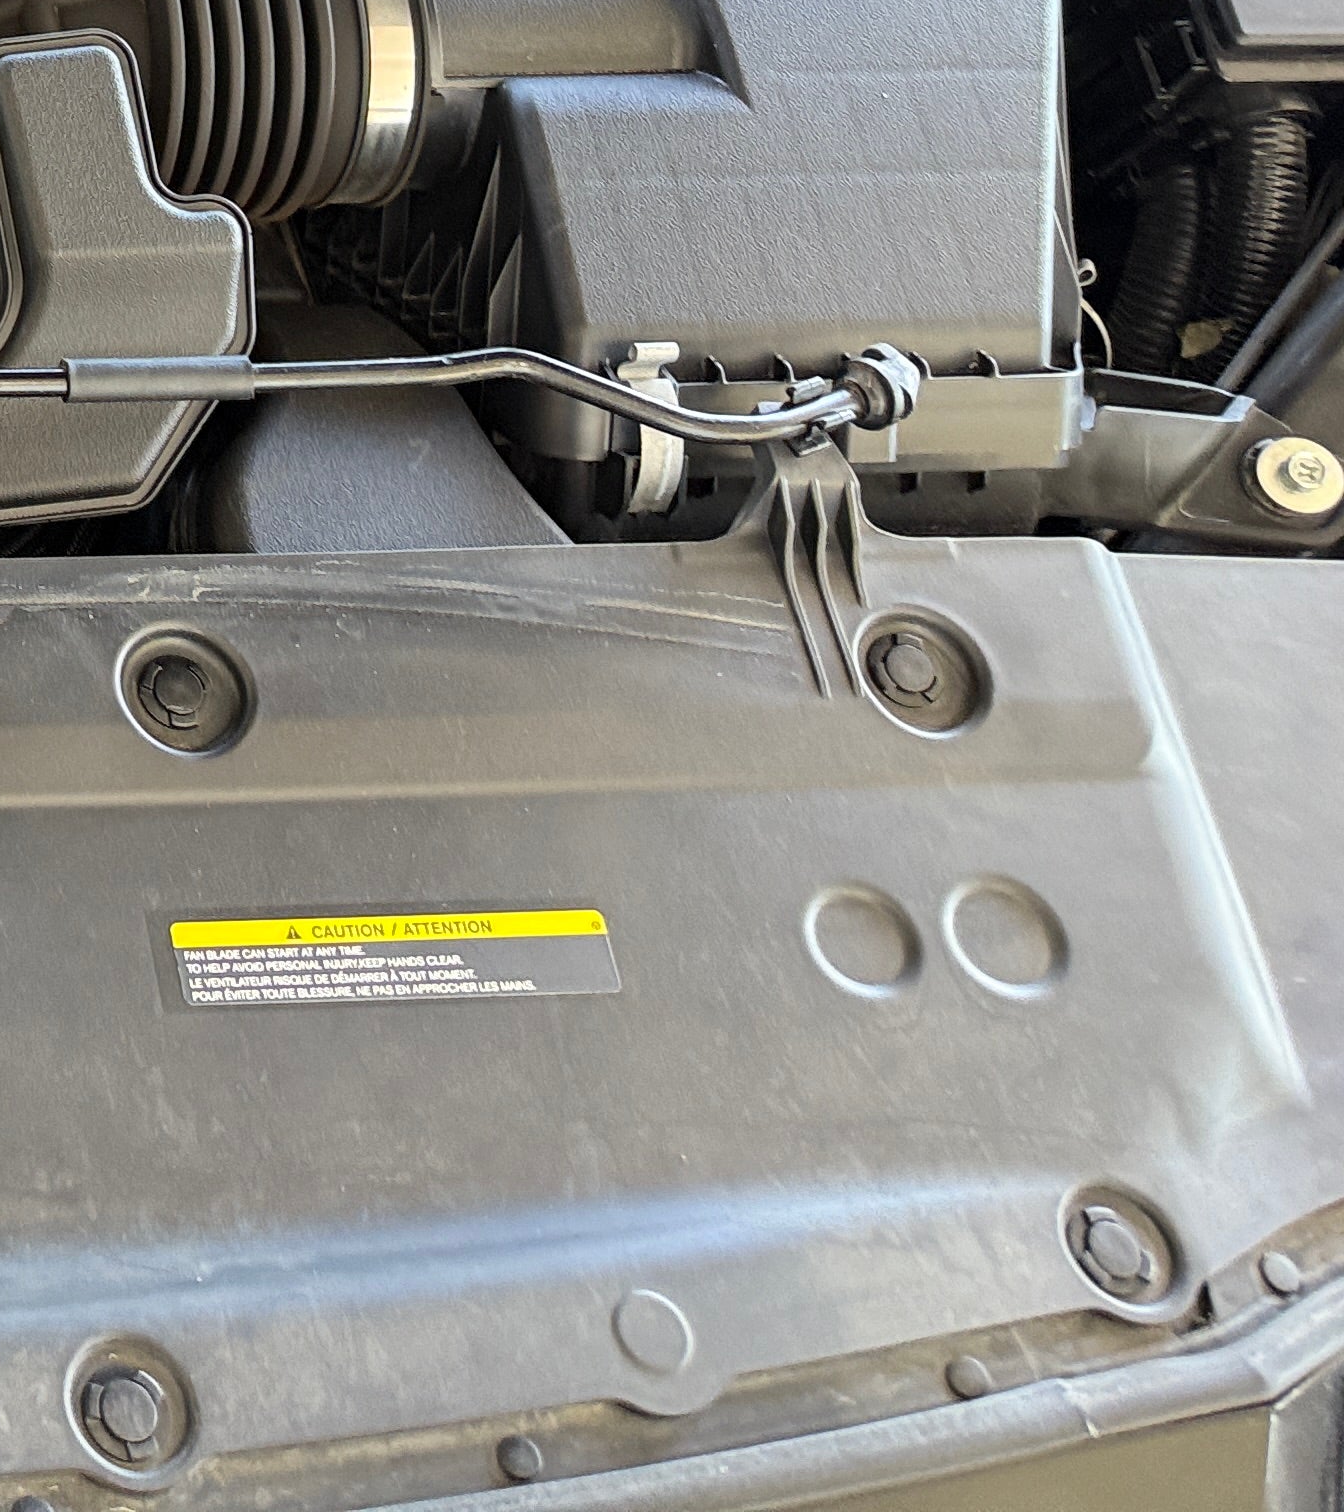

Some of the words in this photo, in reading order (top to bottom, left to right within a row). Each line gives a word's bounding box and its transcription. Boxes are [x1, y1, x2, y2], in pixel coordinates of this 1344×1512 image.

[311, 923, 385, 939] CAUTION
[403, 919, 493, 937] ATTENTION
[183, 950, 205, 961] FAN
[206, 949, 241, 960] BLADE
[242, 948, 265, 959] CAN
[266, 947, 299, 958] START
[301, 947, 313, 958] AT
[315, 946, 337, 957] ANY
[186, 963, 202, 974] TO
[203, 962, 230, 974] HELP
[232, 961, 263, 973] AVOID
[265, 959, 322, 971] PERSONAL
[387, 956, 425, 967] HANDS
[189, 977, 203, 988] LE
[204, 975, 273, 988] VENTILATEUR
[273, 974, 312, 986] RISQUE
[314, 973, 328, 985] DE
[331, 971, 388, 985] DÉMARRER
[399, 970, 428, 981] TOUT
[192, 990, 223, 1002] POUR
[224, 987, 261, 1001] ÉVITER
[262, 988, 296, 1000] TOUTE
[356, 985, 372, 997] NE
[373, 984, 394, 996] PAS
[395, 984, 411, 995] EN
[412, 981, 477, 995] APPROCHER
[478, 981, 499, 992] LES
